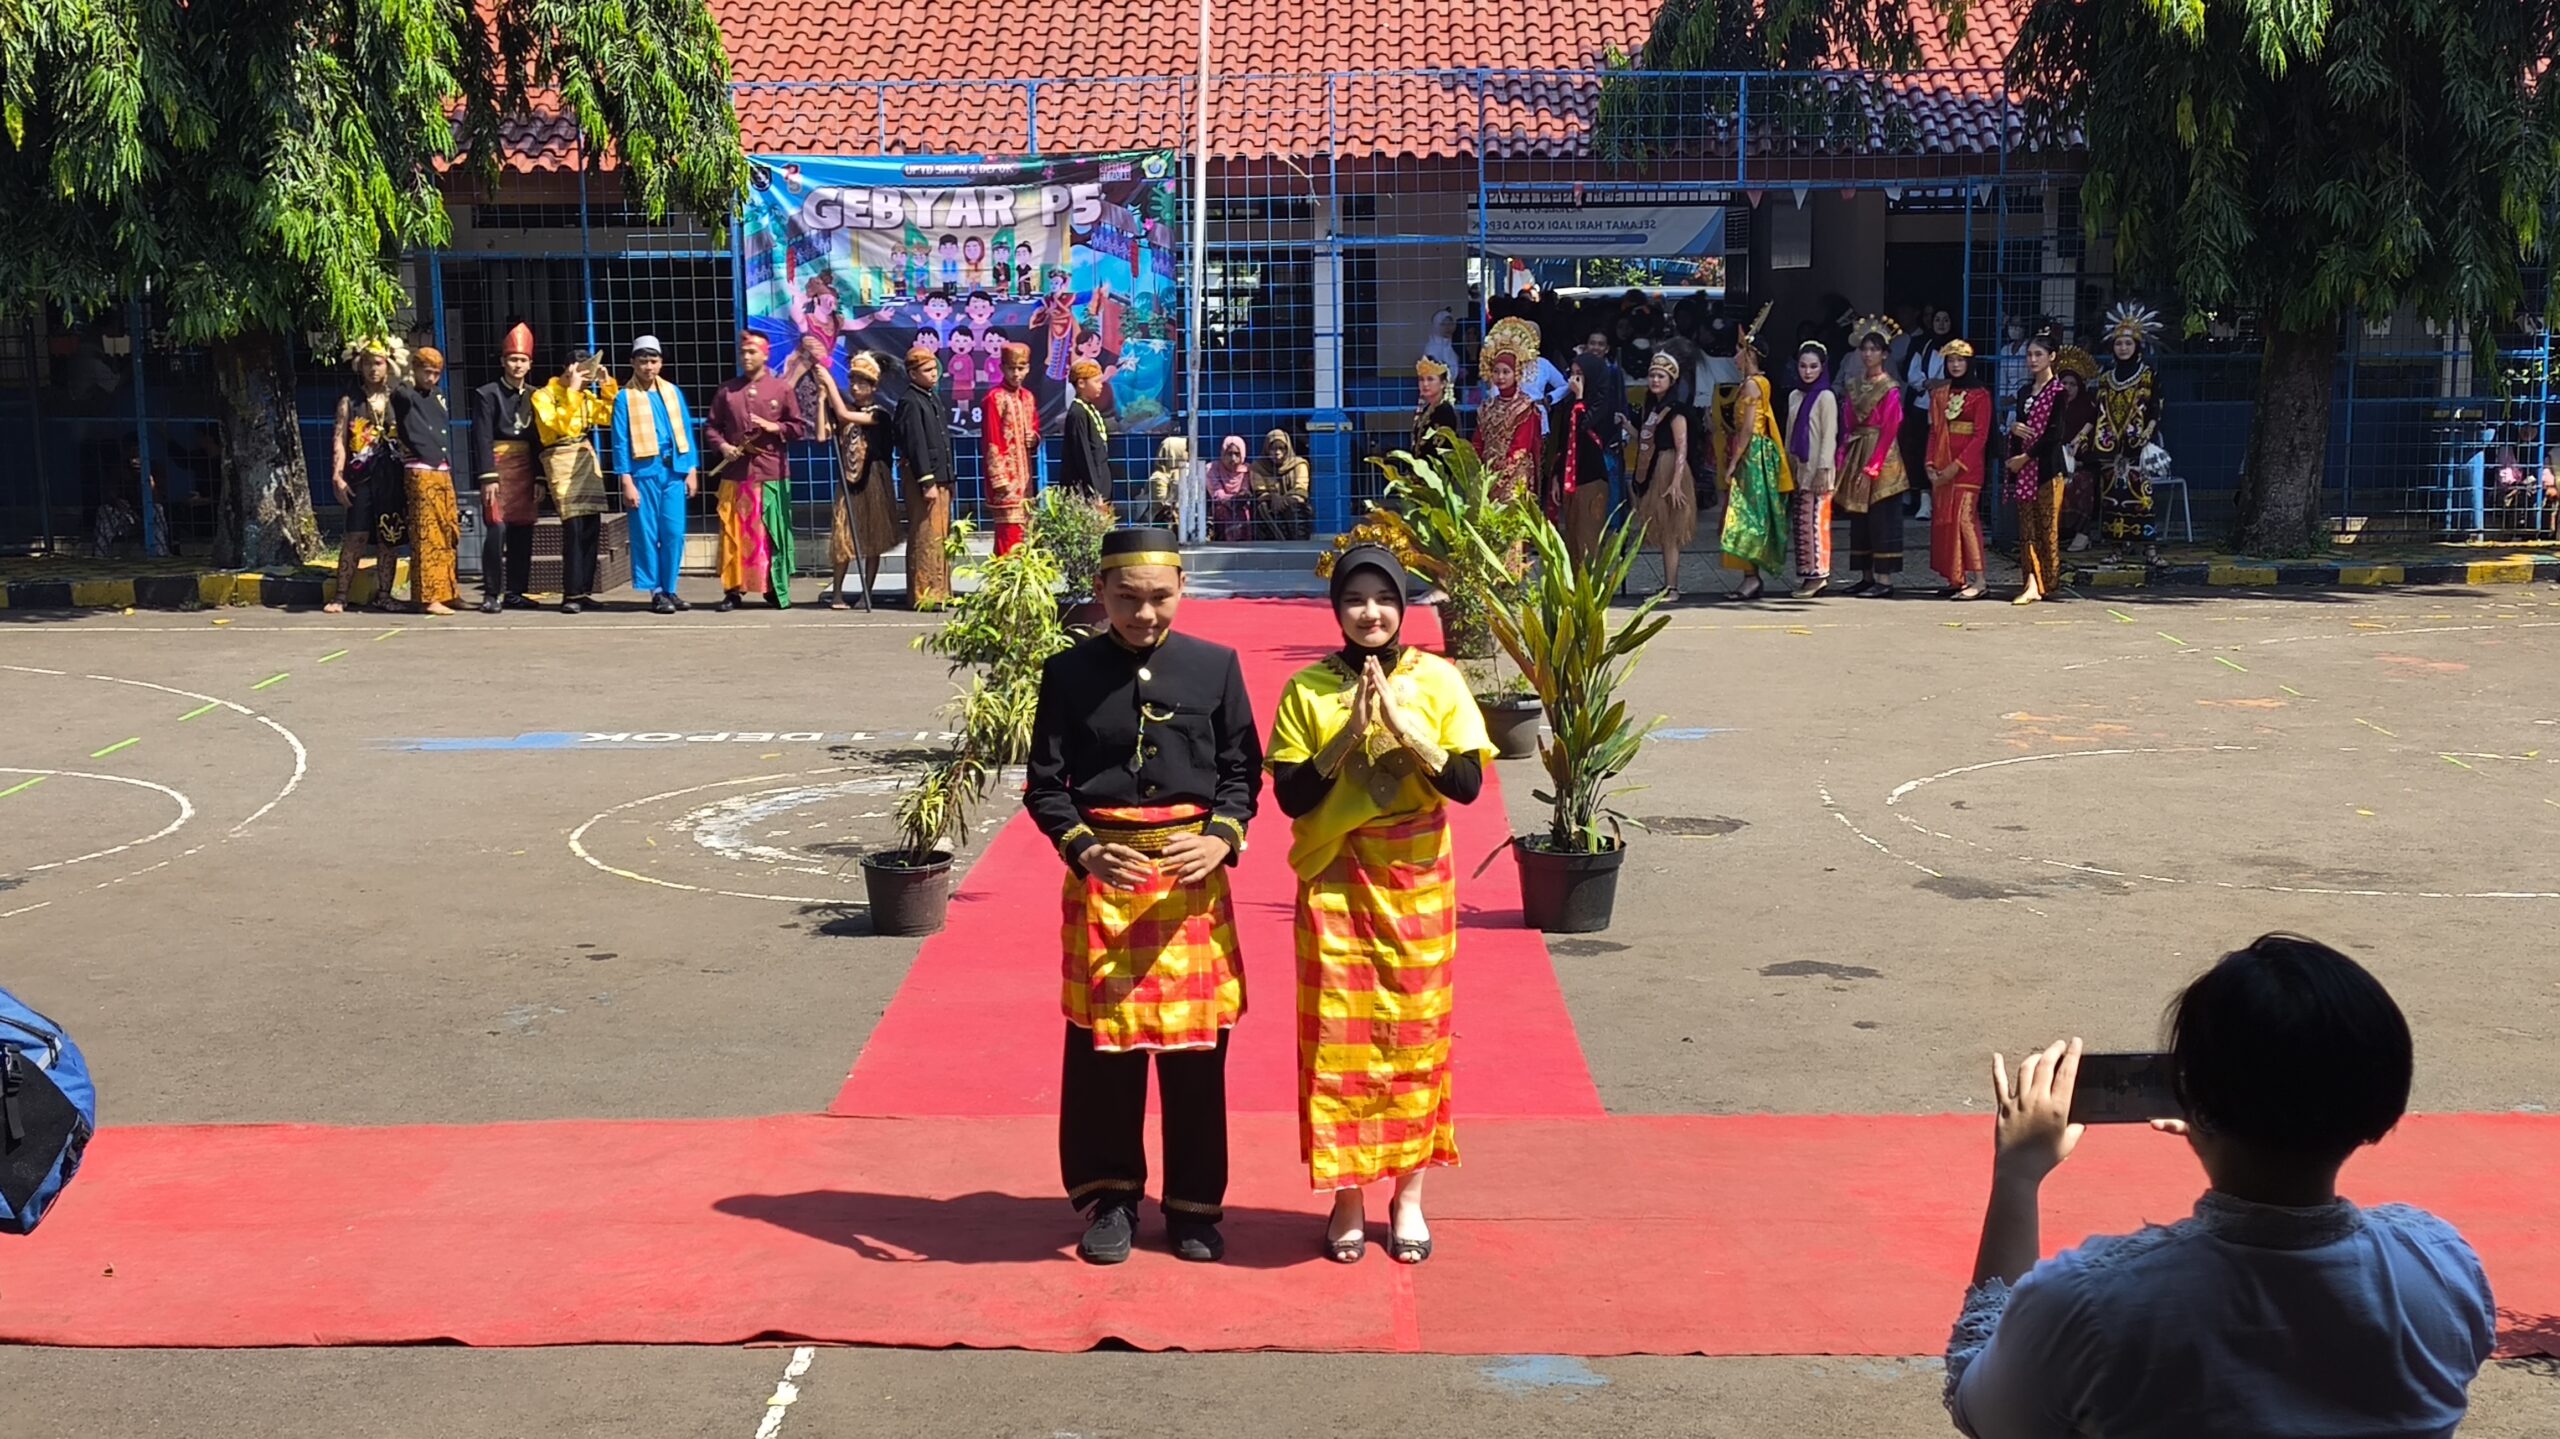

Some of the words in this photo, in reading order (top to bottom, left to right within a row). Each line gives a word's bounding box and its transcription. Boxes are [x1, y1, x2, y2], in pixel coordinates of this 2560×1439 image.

[802, 185, 1017, 230] GEBYAR
[1040, 183, 1103, 226] P5
[971, 407, 983, 423] 8
[578, 731, 825, 742] DEPOK
[850, 731, 876, 741] 1
